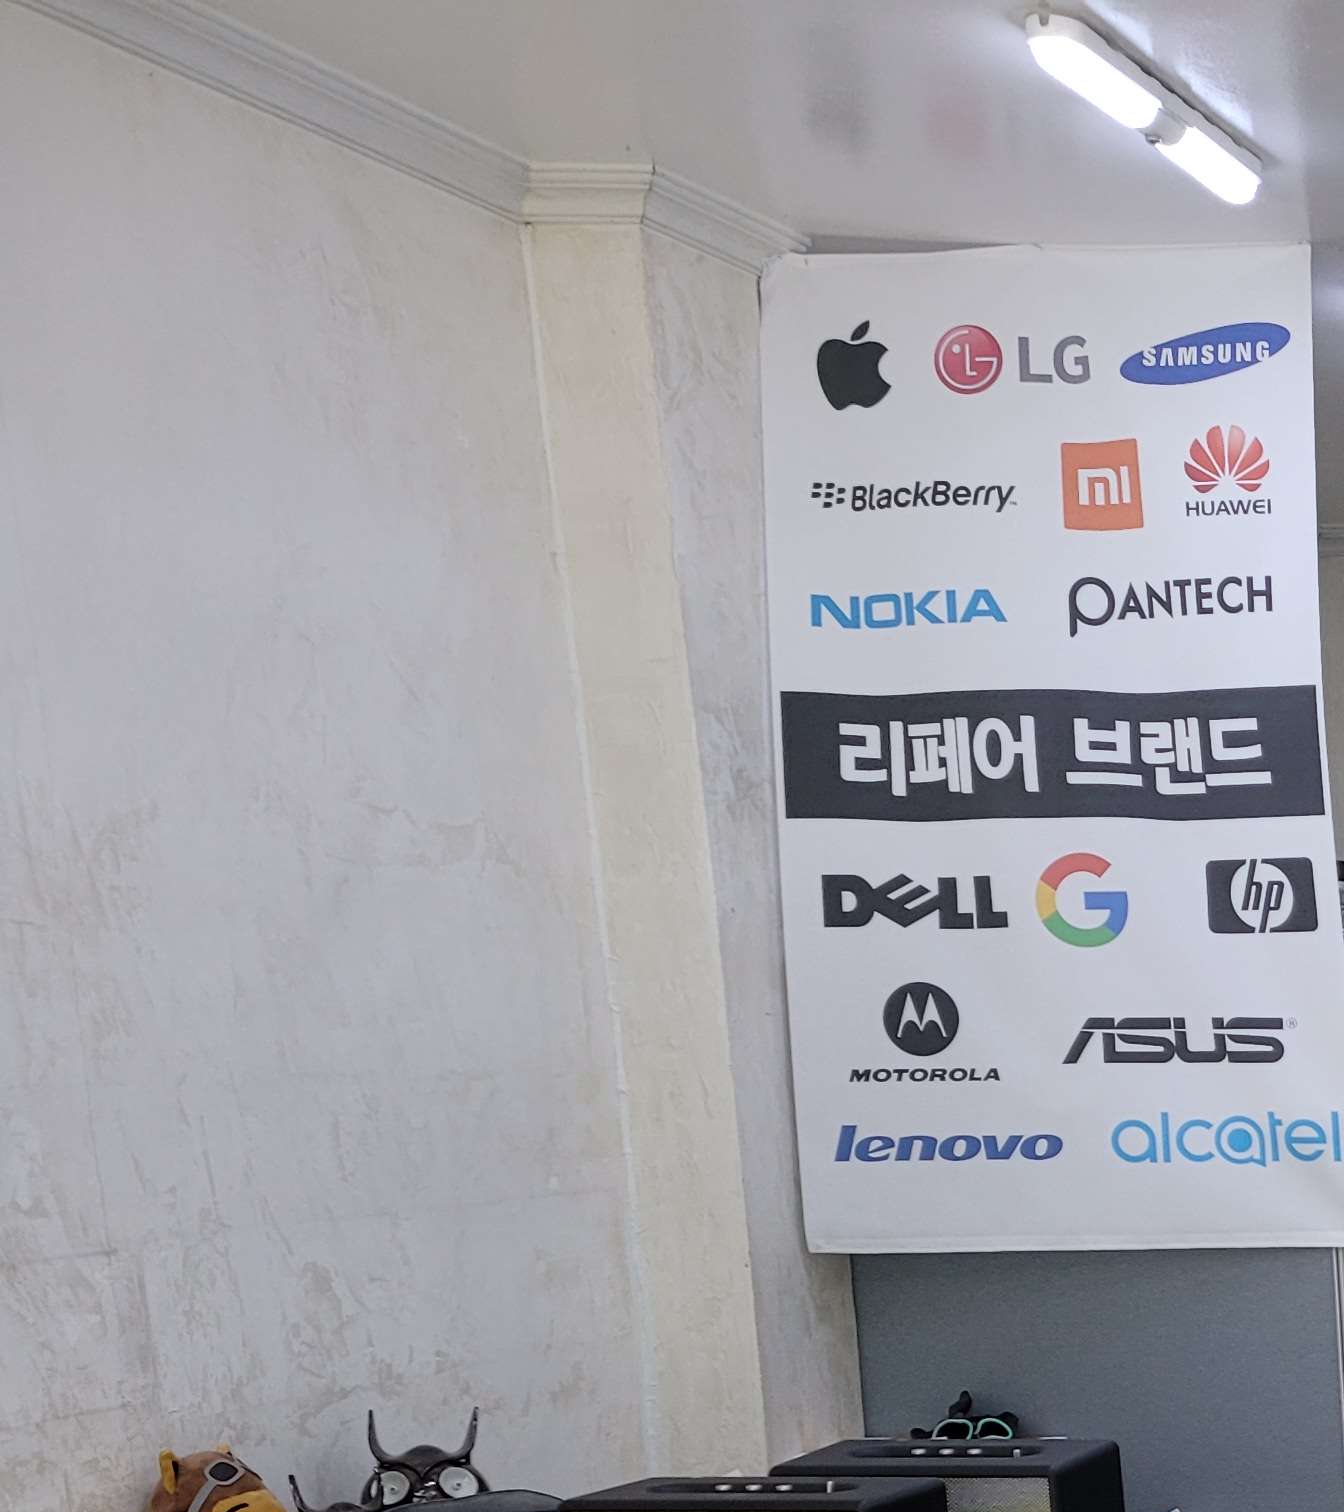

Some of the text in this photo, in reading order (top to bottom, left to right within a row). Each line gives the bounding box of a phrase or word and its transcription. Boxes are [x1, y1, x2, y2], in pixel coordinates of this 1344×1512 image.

[1018, 335, 1091, 384] LG
[1141, 341, 1271, 368] SAMSUNG
[851, 480, 1017, 513] BlackBerry
[1185, 498, 1272, 517] HUAWEI
[810, 588, 1008, 629] NOKIA
[1069, 575, 1273, 637] PANTECH
[838, 714, 1273, 797] 리페어 브랜드
[821, 873, 1009, 930] DELL
[1062, 1016, 1285, 1064] ASUS
[849, 1067, 1001, 1083] MOTOROLA
[833, 1125, 1064, 1163] lenovo
[1111, 1111, 1343, 1168] alcatel
